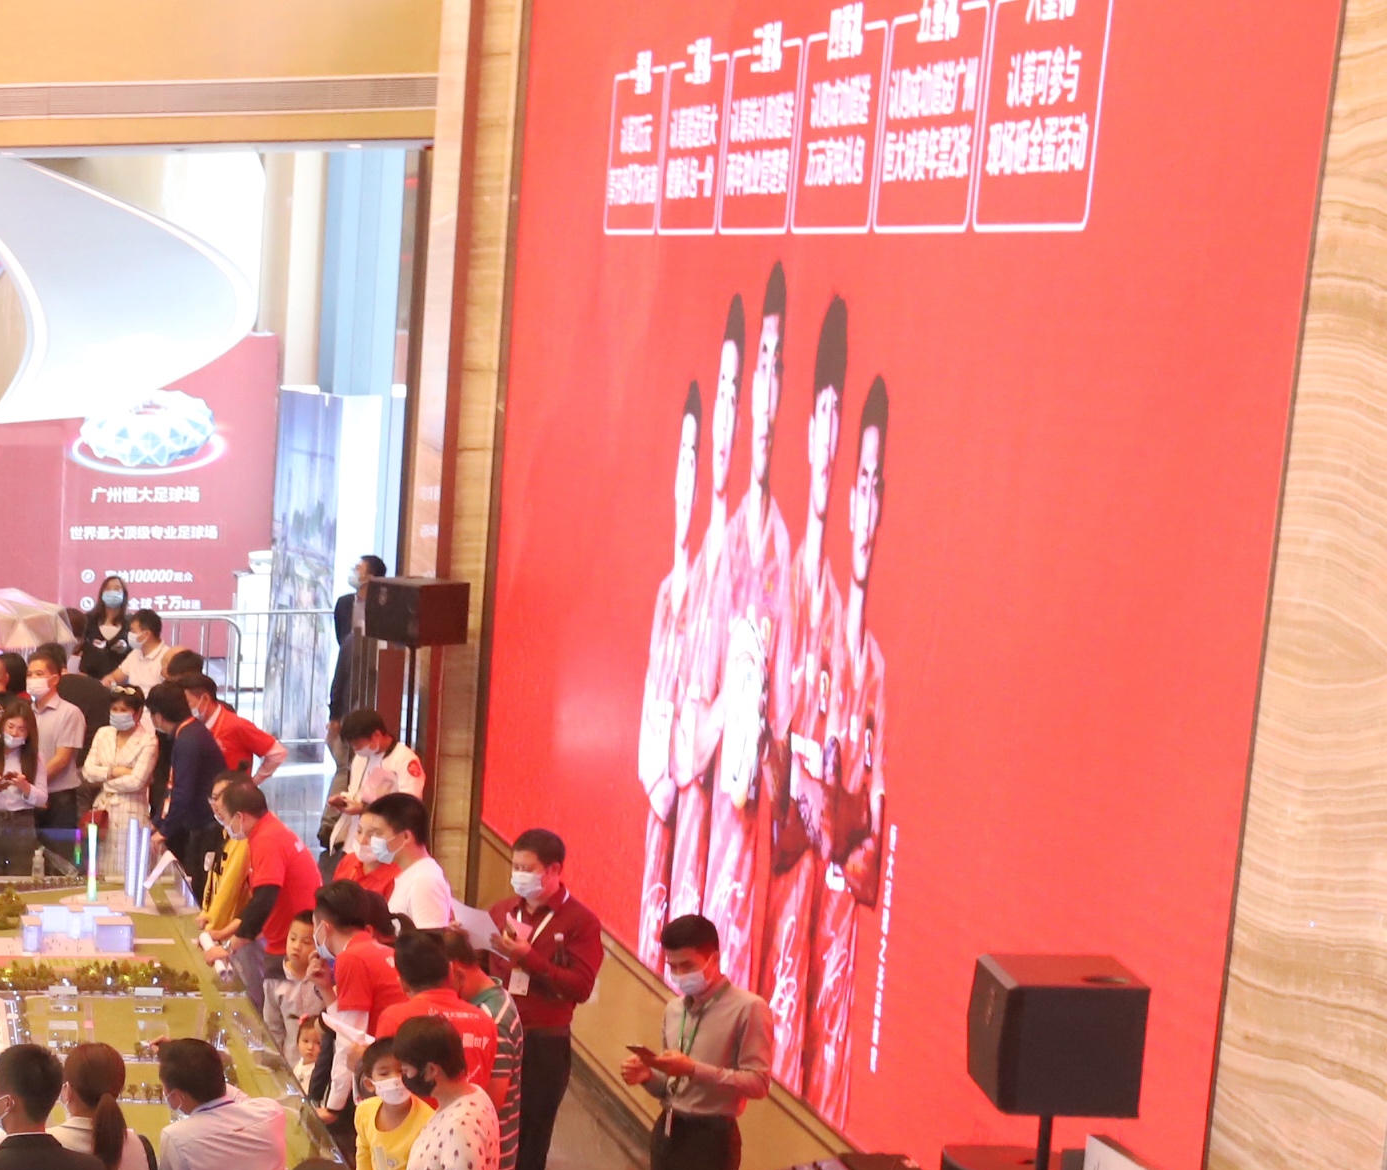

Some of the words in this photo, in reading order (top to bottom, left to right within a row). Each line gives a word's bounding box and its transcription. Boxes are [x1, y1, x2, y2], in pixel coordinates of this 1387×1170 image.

[1007, 44, 1083, 109] 认筹可参与
[986, 113, 1089, 176] 现场砸金蛋活动
[91, 486, 201, 504] 广州恒大足球场
[69, 525, 218, 541] 世界最大顶级专业足球场
